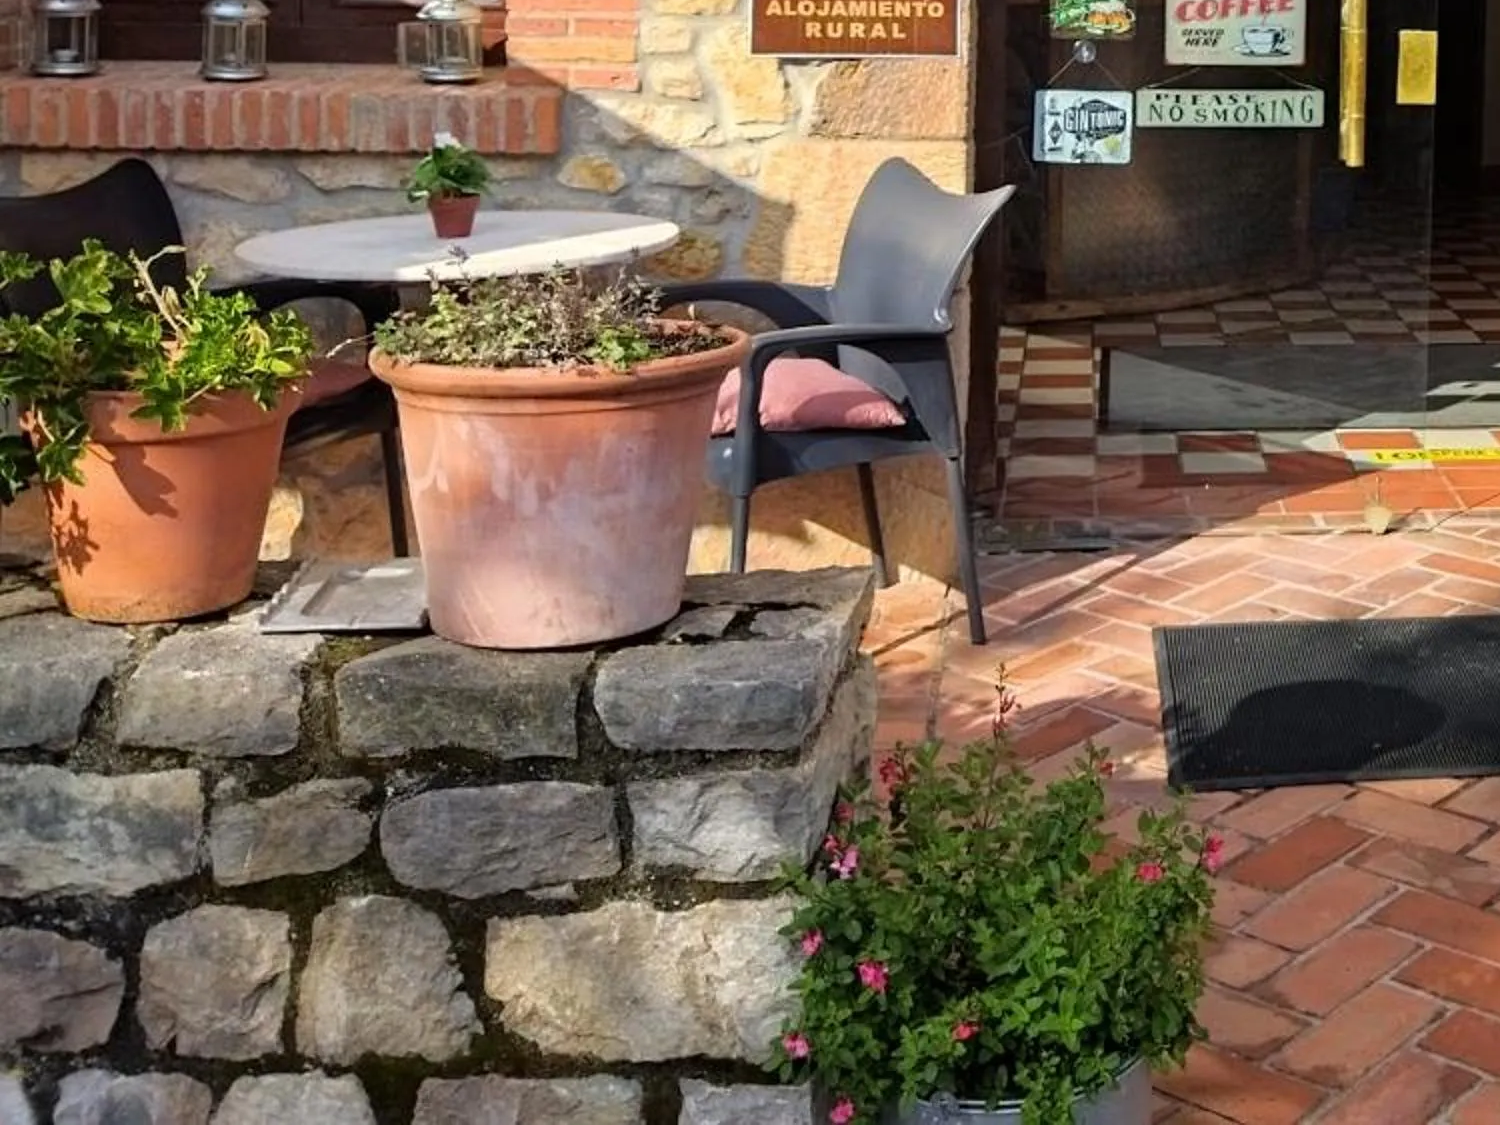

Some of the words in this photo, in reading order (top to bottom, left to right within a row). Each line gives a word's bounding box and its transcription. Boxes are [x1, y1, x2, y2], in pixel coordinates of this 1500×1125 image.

[765, 0, 945, 19] ALOJAMIENTO
[804, 21, 907, 40] RURAL
[1181, 27, 1225, 38] SERVED
[1184, 37, 1219, 48] HERE
[1155, 93, 1257, 105] PLEASE
[1149, 104, 1184, 122] NO
[1194, 94, 1314, 123] SMOKING
